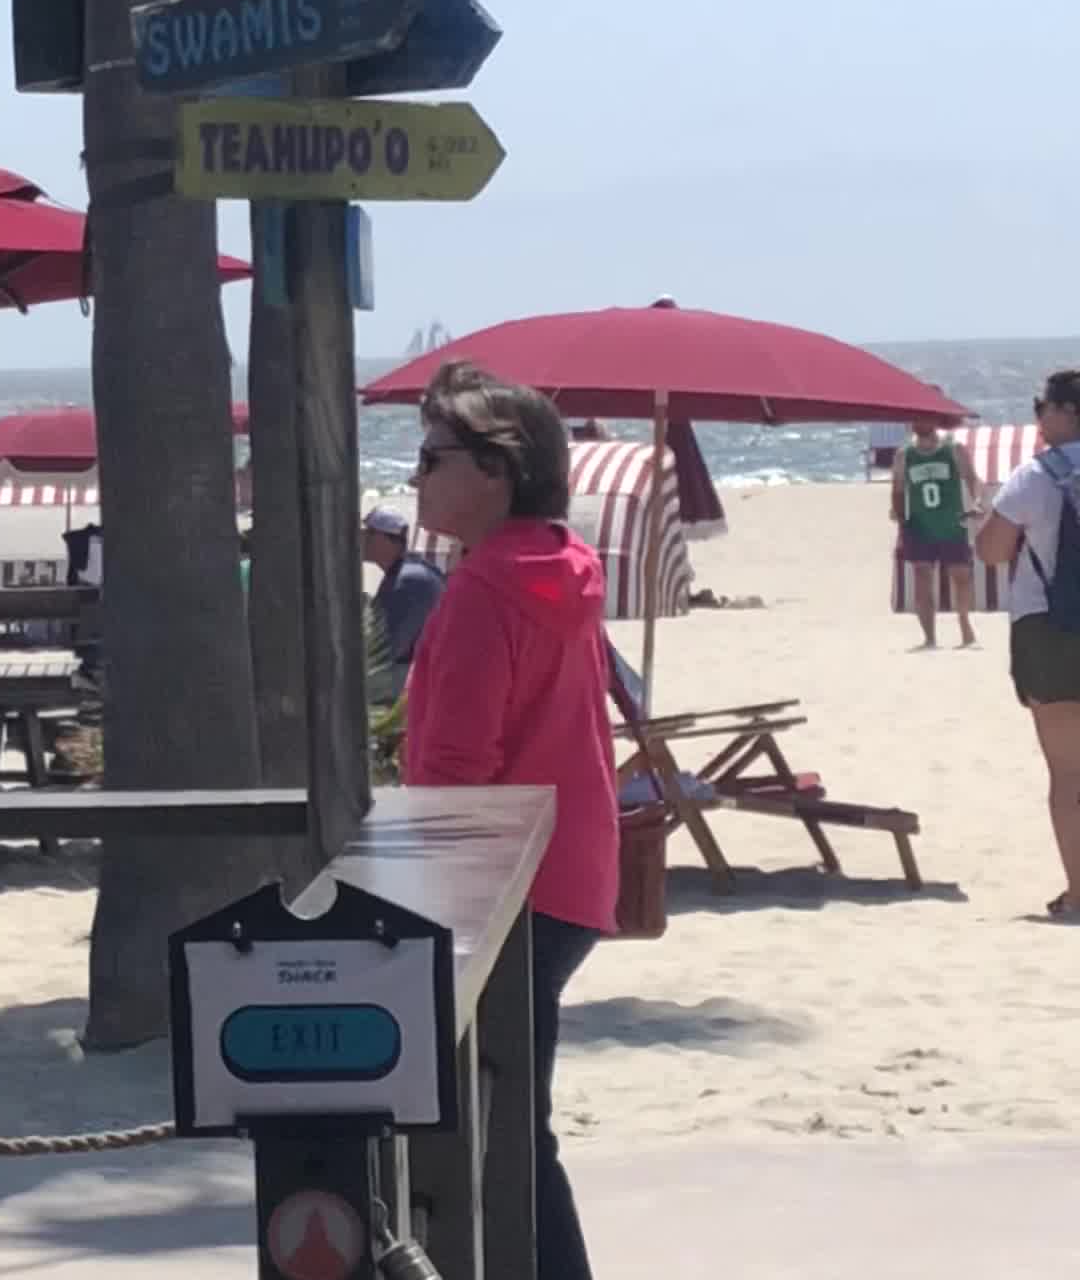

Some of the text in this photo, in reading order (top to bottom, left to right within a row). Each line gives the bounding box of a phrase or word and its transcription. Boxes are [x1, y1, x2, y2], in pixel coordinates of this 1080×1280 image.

[199, 119, 410, 175] TEAHUPO'O
[923, 482, 941, 508] 0
[271, 1022, 343, 1054] EXIT
